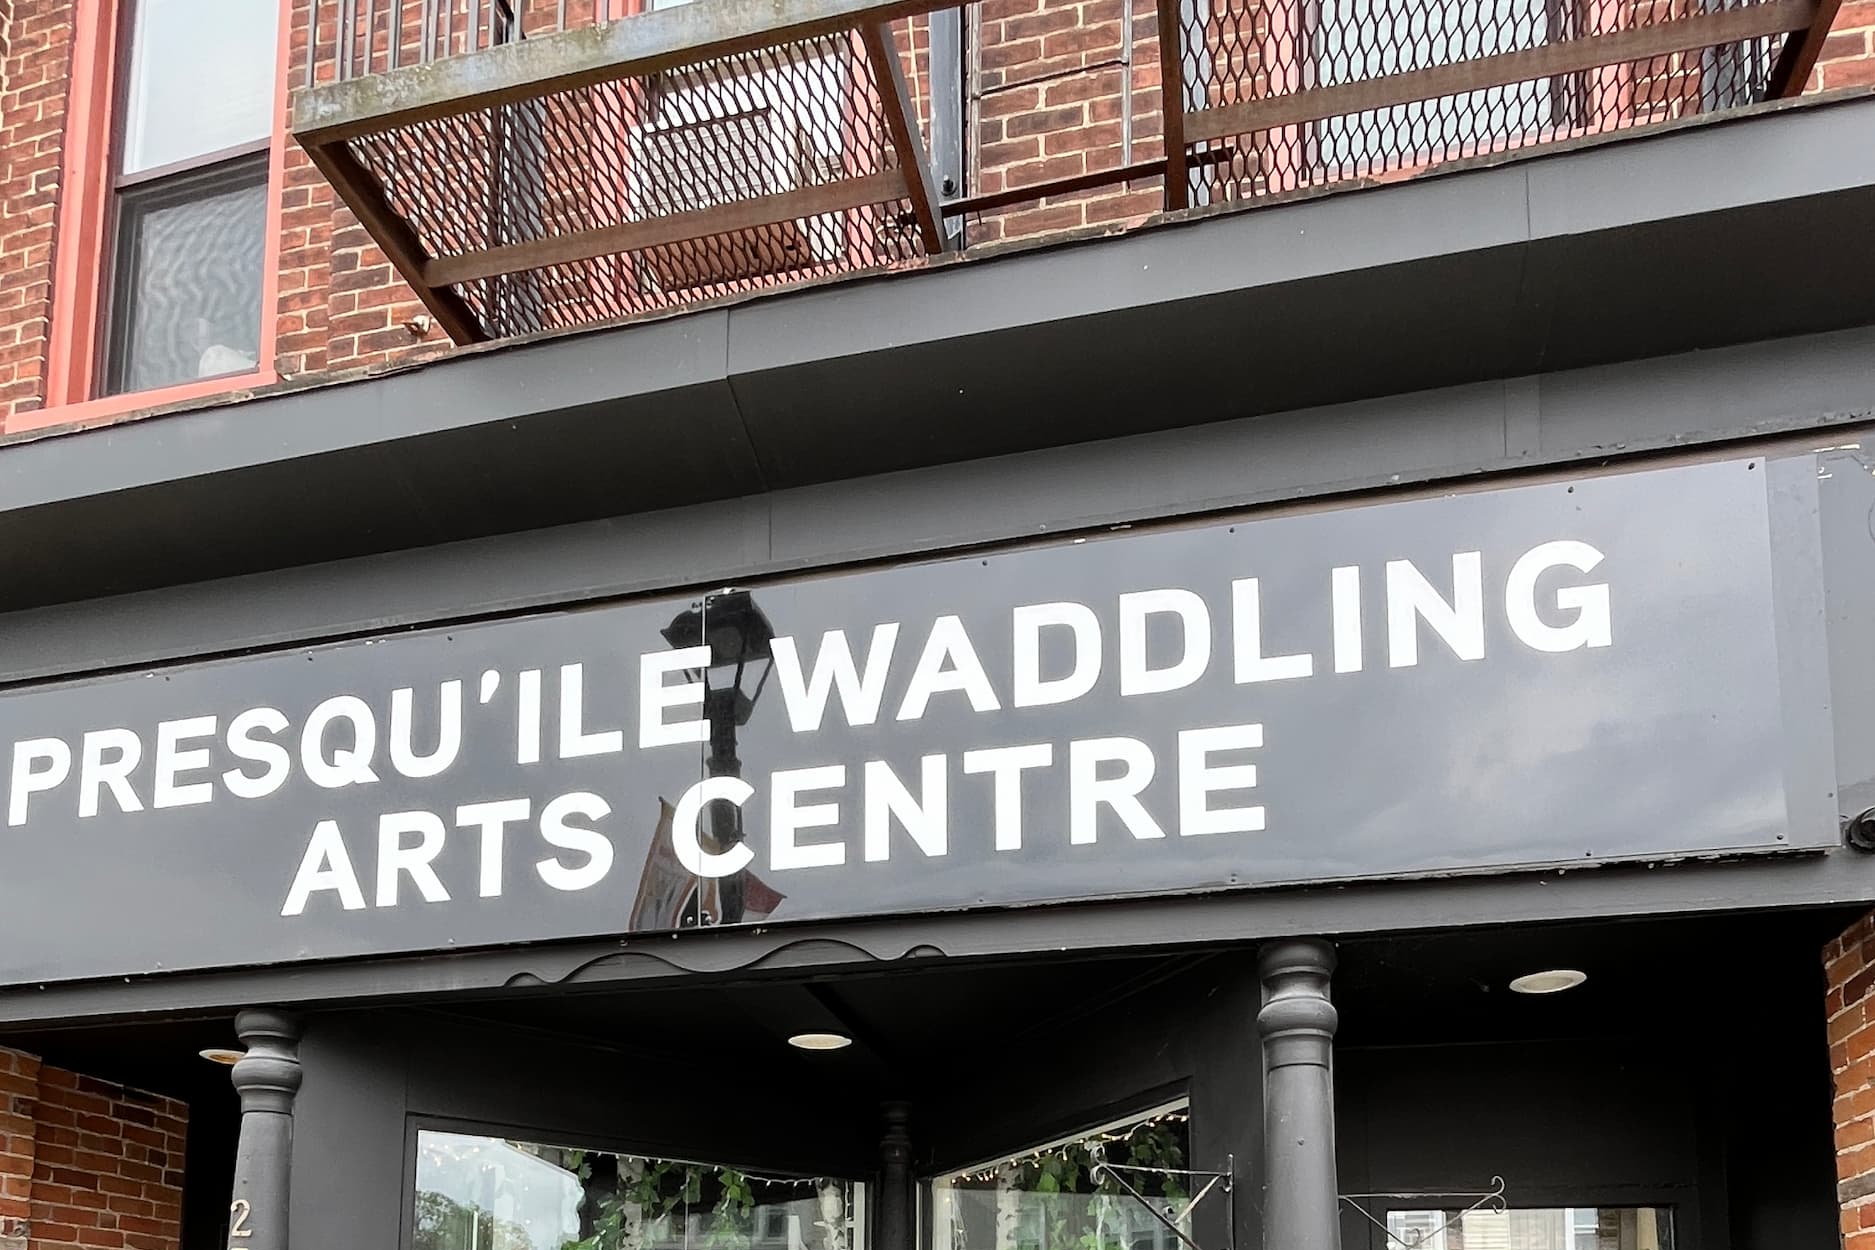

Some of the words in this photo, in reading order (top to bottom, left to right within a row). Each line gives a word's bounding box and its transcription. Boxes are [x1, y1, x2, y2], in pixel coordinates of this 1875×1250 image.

[7, 645, 712, 827] PRESQU'ILE
[769, 540, 1613, 733] WADDLING
[280, 792, 614, 917] ARTS
[672, 723, 1265, 878] CENTRE
